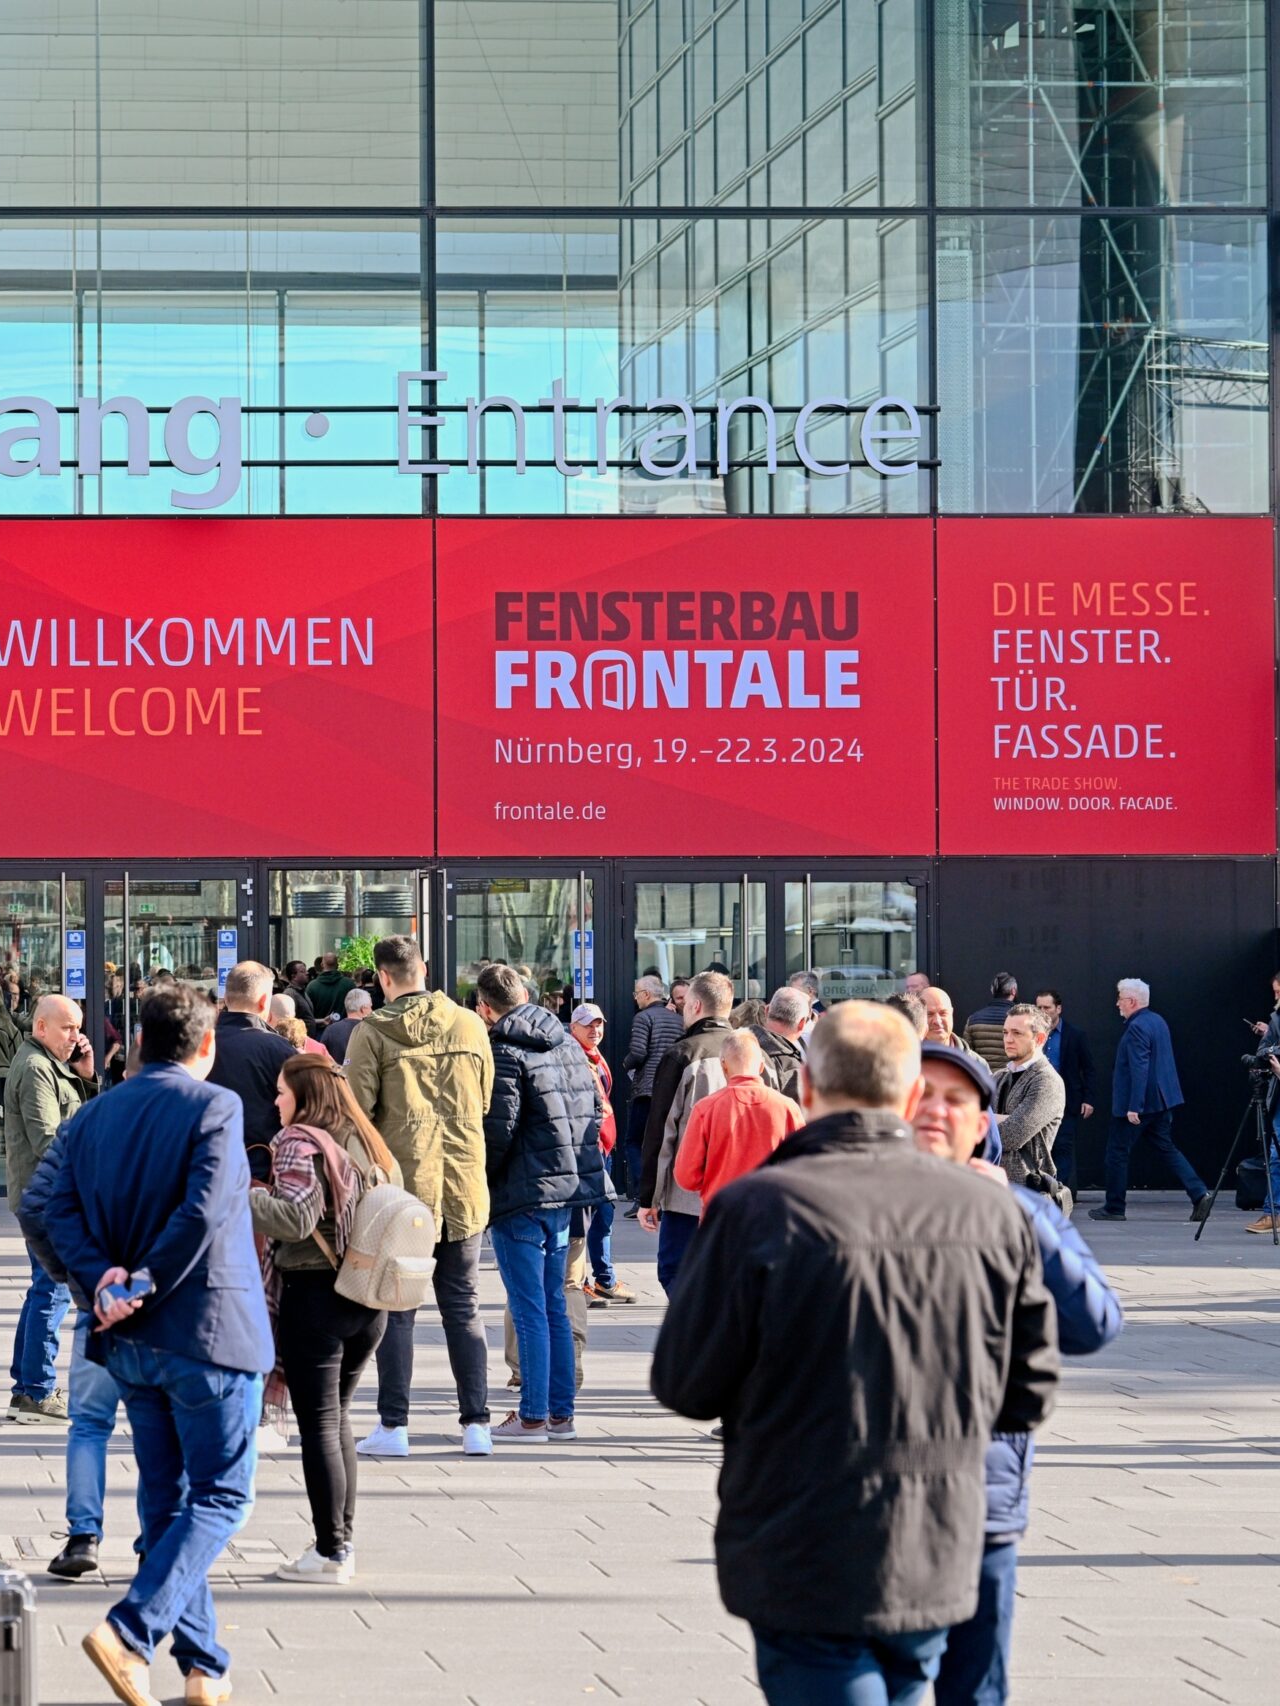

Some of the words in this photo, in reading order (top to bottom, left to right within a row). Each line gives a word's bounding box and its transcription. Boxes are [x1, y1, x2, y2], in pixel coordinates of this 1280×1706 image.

[397, 371, 922, 477] Entrance
[494, 591, 860, 642] FENSTERBAU
[993, 582, 1056, 616] DIE
[1072, 582, 1210, 616] MESSE.
[993, 629, 1171, 664] FENSTER.
[495, 649, 861, 711] FRONTALE
[990, 669, 1077, 712] TÜR.
[495, 737, 642, 768] Nürnberg,
[993, 724, 1176, 759] FASSADE.
[993, 777, 1020, 791] THE
[1024, 777, 1070, 791] TRADE
[1074, 777, 1122, 791] SHOW.
[494, 801, 606, 820] frontale.de
[993, 797, 1064, 810] WINDOW.
[1069, 797, 1115, 810] DOOR.
[1119, 797, 1177, 810] FACADE.
